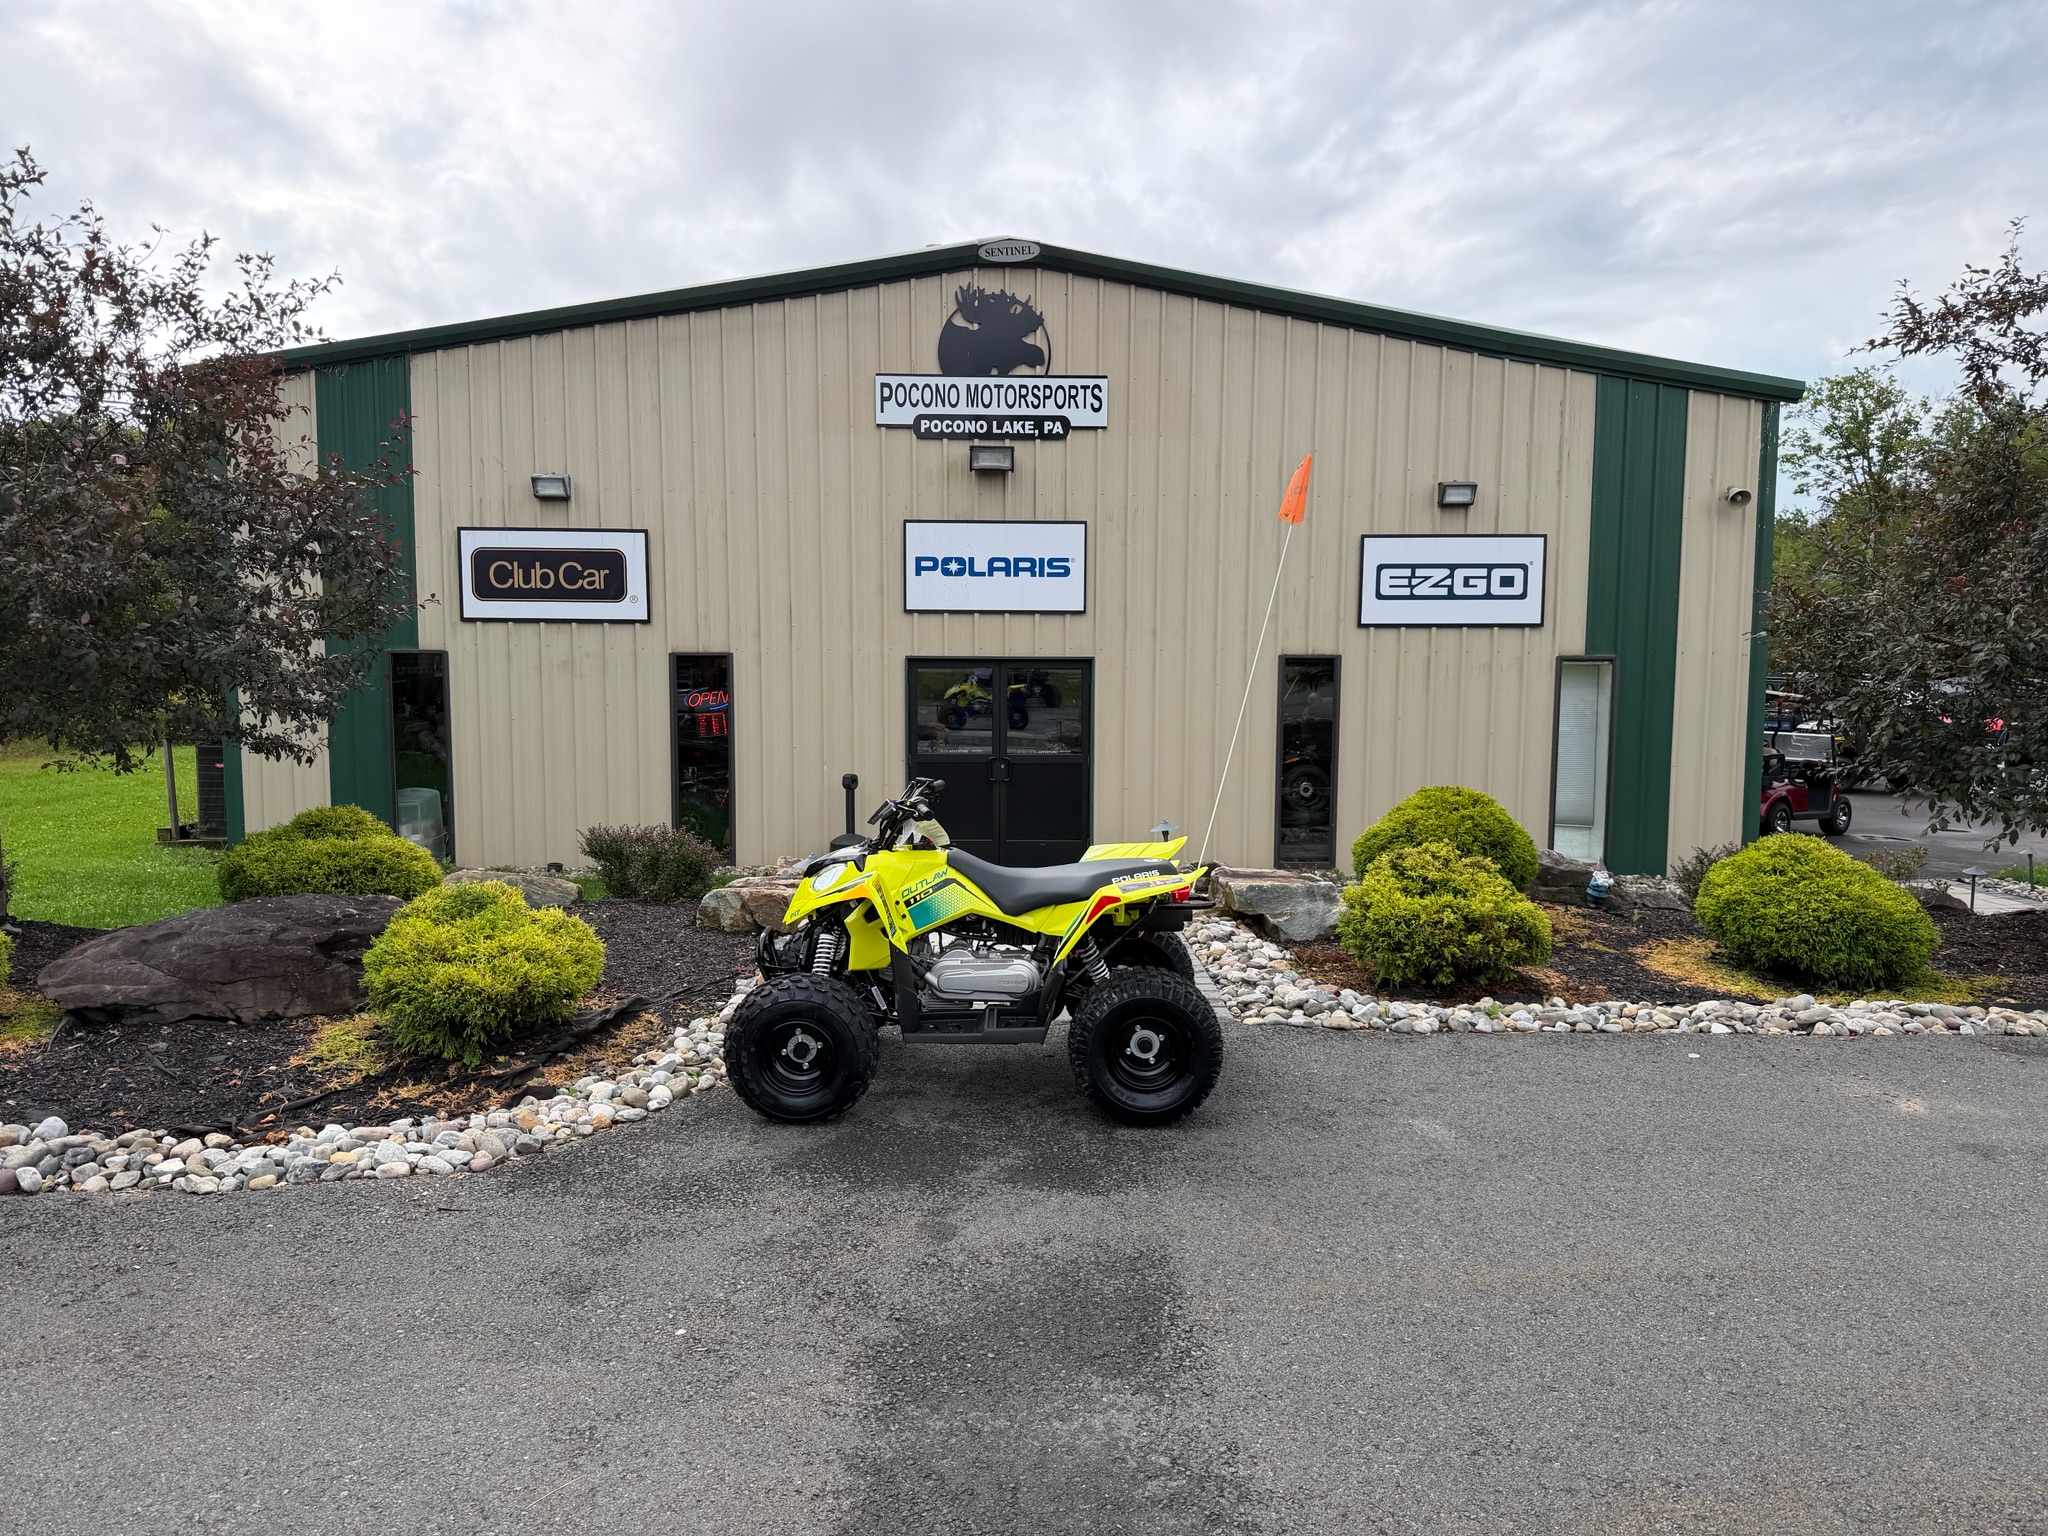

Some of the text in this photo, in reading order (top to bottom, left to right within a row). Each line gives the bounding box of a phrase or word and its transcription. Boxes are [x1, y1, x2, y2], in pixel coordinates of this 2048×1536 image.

[984, 245, 1035, 258] SENTINEL
[880, 382, 1103, 414] POCONO MOTORSPORTS
[920, 419, 1064, 437] POCONO LAKE, PA
[488, 560, 610, 590] Club Car
[914, 556, 1072, 578] POLARIS
[1379, 567, 1525, 596] EZGO
[688, 690, 729, 707] OPEN
[901, 867, 949, 899] OUTLAW
[1111, 869, 1160, 885] POLARIS
[909, 887, 933, 905] 110
